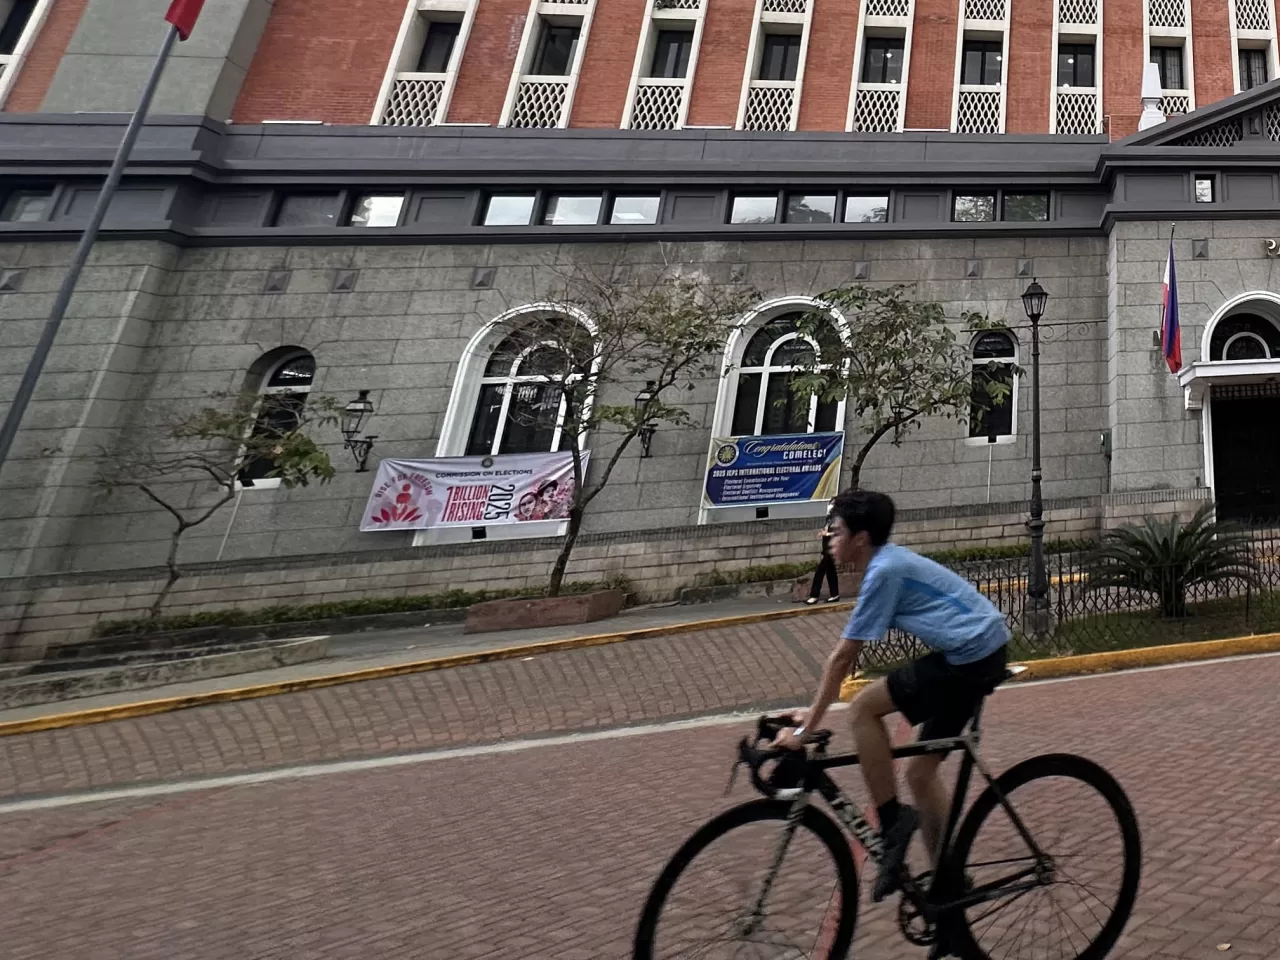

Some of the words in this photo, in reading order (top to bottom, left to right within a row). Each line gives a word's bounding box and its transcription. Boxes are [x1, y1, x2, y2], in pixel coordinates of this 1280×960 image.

[783, 448, 827, 460] COMELEC!
[494, 468, 533, 476] ELECTIONS
[738, 467, 775, 476] INTERNATIONAL
[453, 484, 491, 501] BILLION
[483, 484, 516, 520] 2025
[446, 501, 486, 522] RISING
